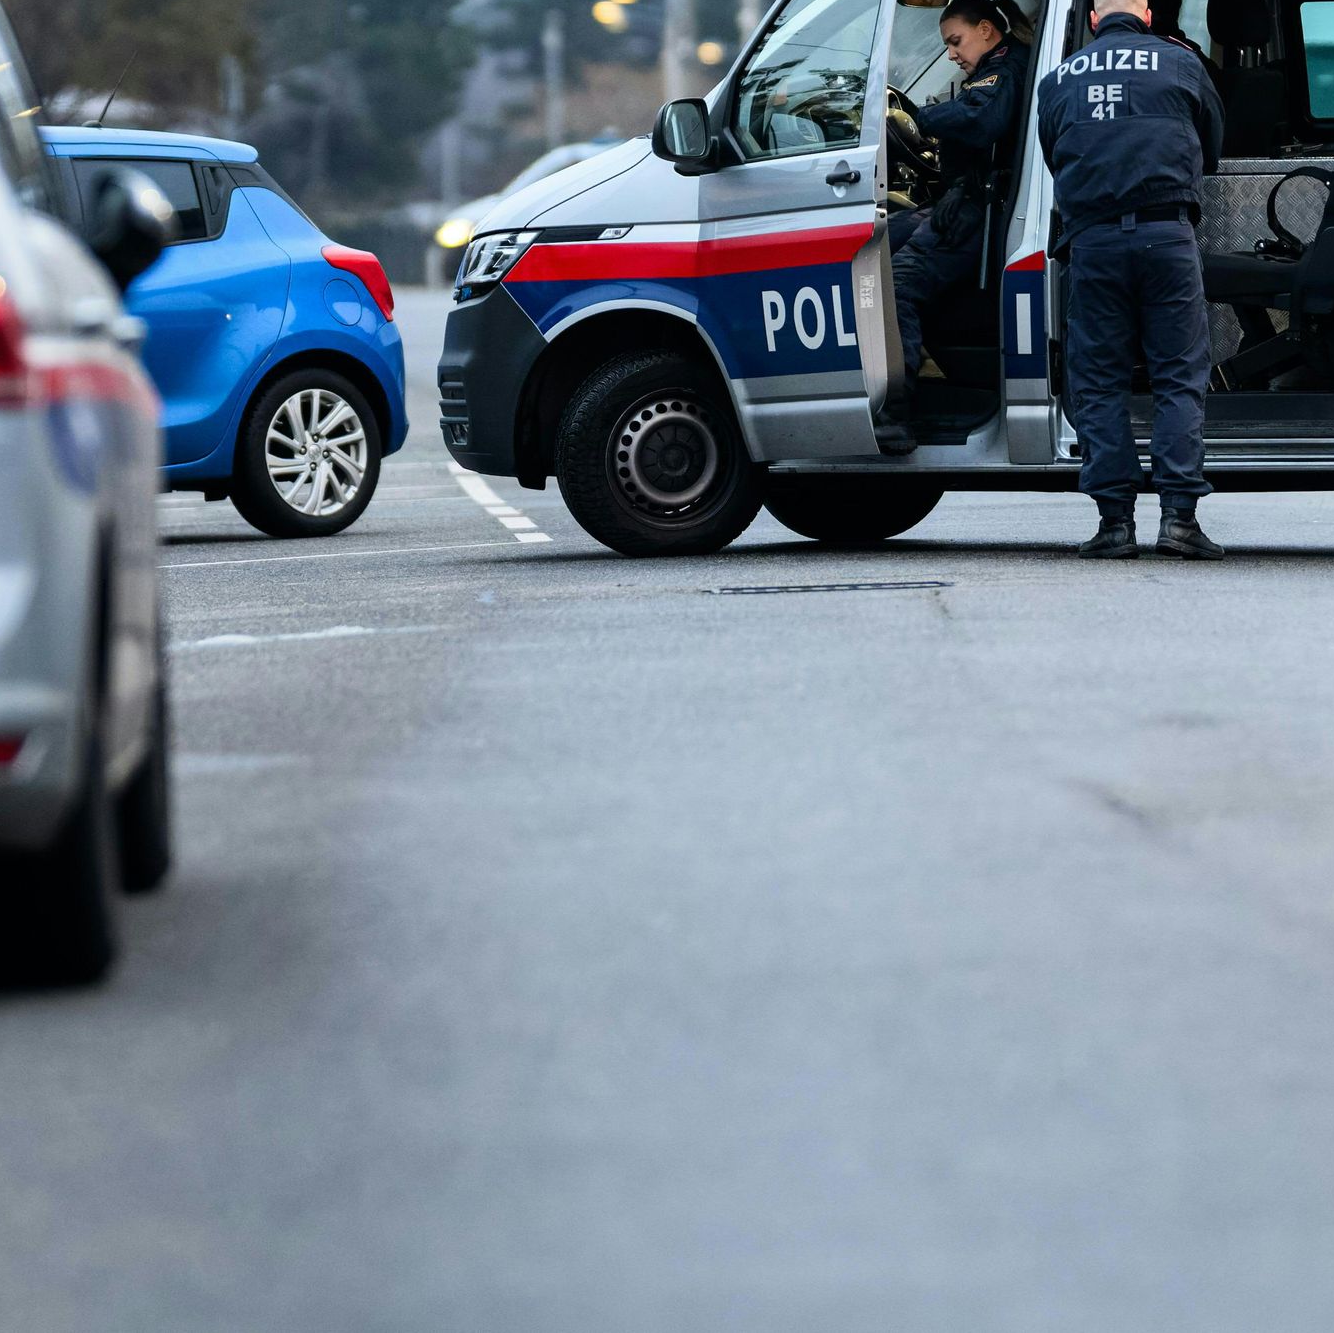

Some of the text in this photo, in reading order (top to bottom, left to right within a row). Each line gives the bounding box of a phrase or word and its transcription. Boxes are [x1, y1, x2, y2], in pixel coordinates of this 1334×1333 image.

[1056, 49, 1159, 85] POLIZEI
[1087, 84, 1123, 103] BE
[1091, 103, 1115, 121] 41
[761, 284, 858, 353] POL
